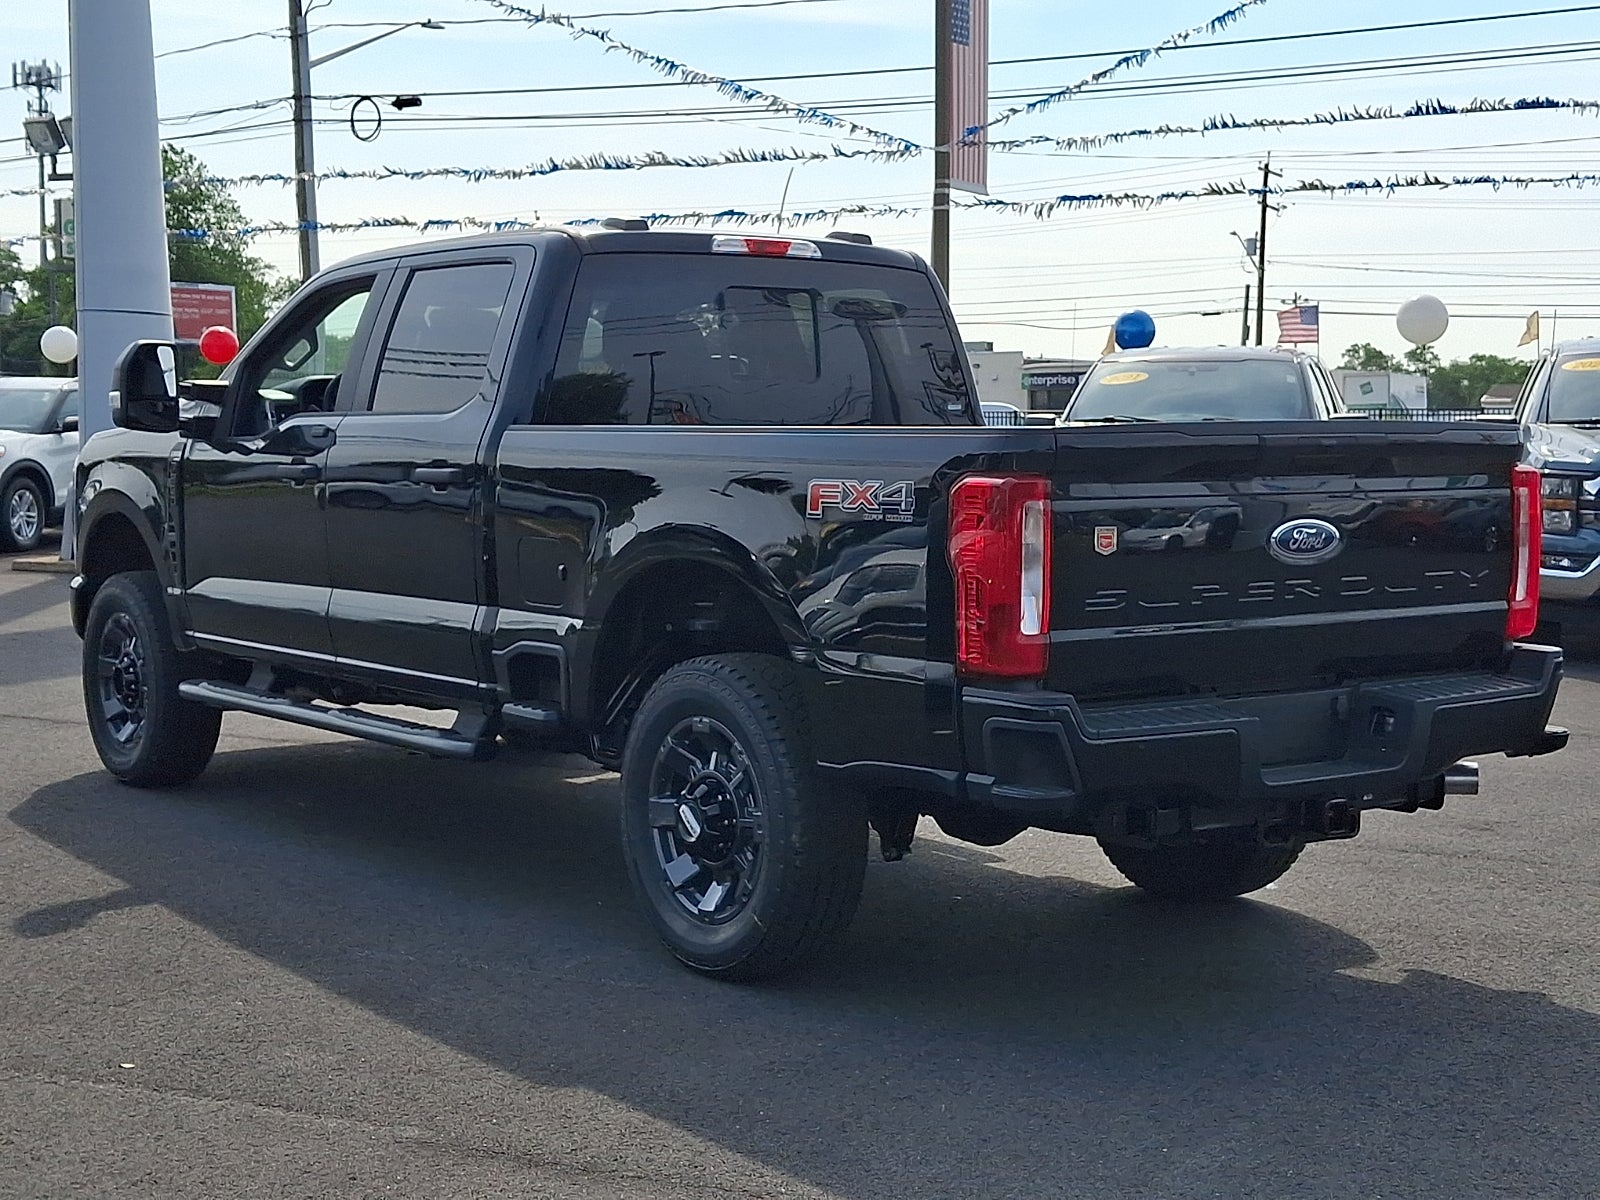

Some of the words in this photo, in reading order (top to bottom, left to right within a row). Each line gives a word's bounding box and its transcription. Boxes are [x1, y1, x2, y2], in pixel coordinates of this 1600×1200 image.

[1023, 374, 1076, 387] enterprise
[806, 478, 915, 518] FX4
[1289, 527, 1326, 549] Ford
[1085, 580, 1322, 611] SUPER
[1340, 570, 1490, 596] DUTY
